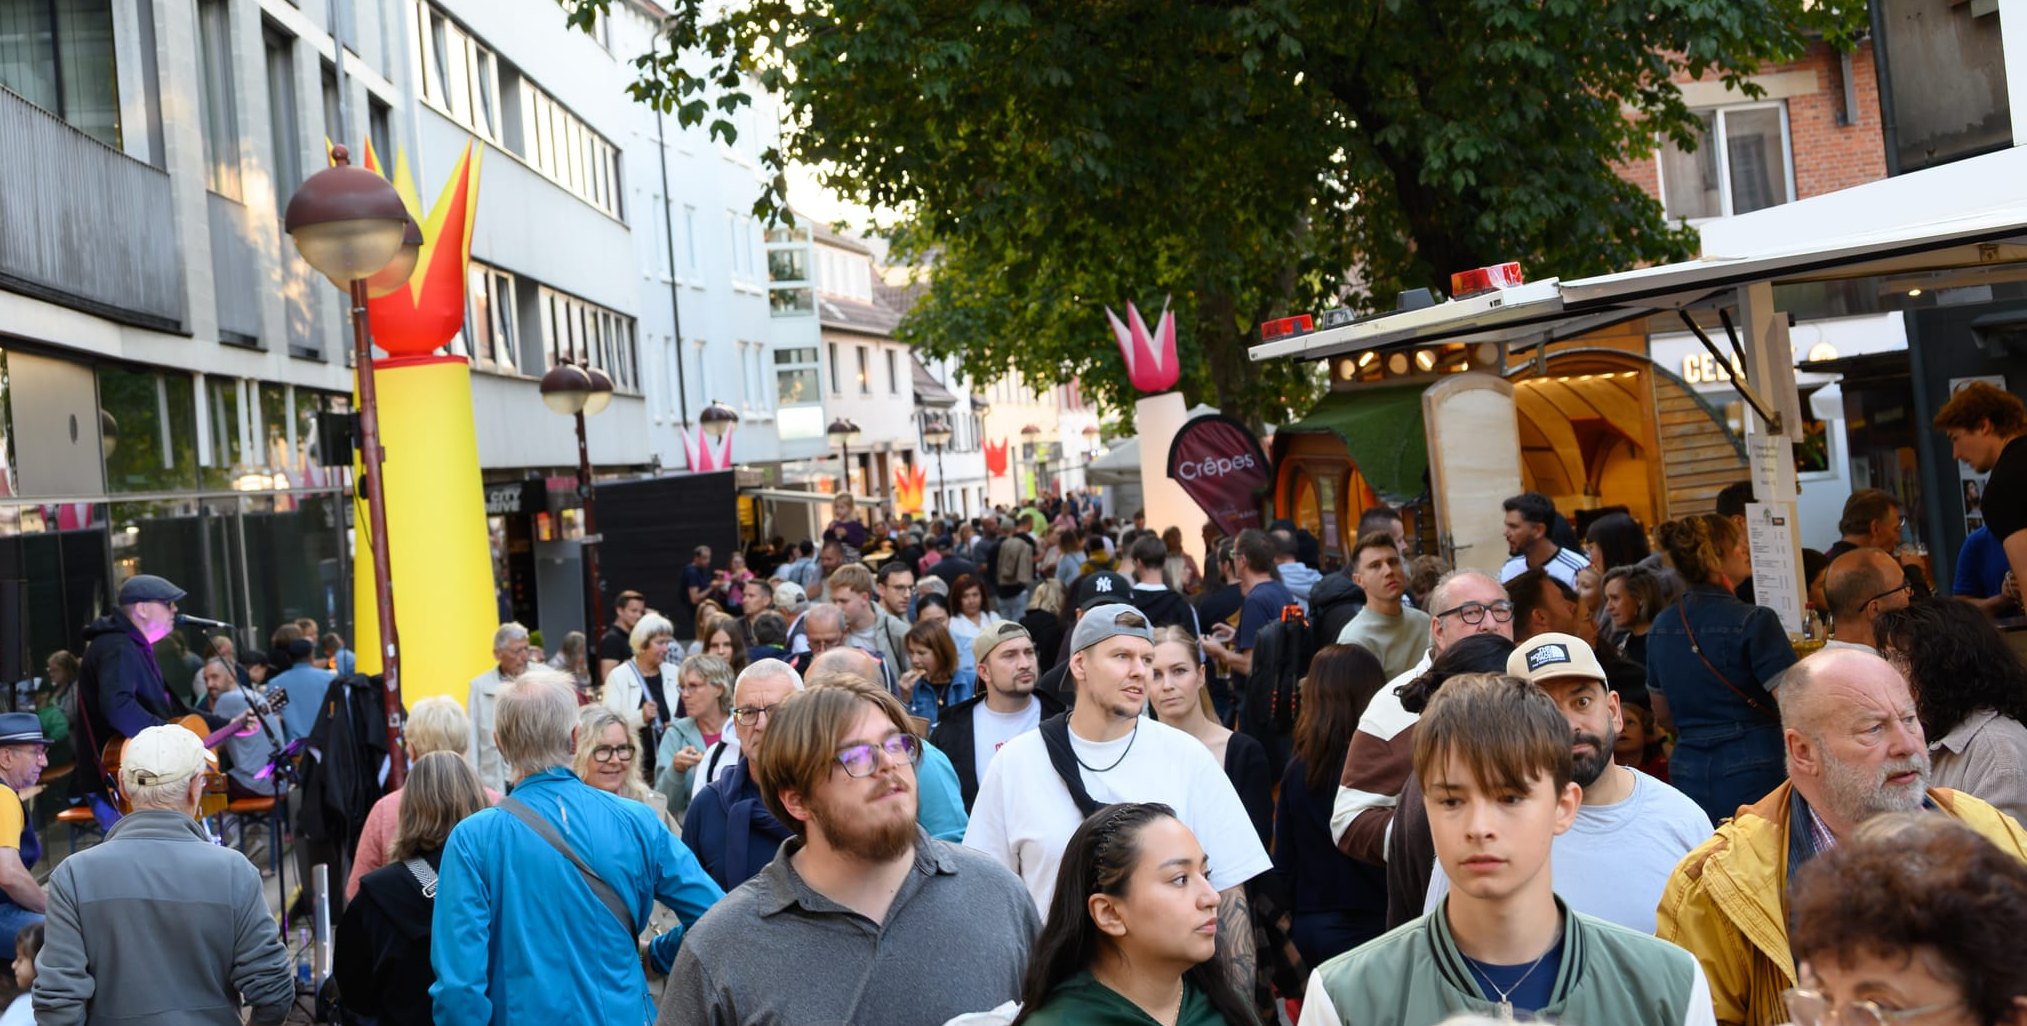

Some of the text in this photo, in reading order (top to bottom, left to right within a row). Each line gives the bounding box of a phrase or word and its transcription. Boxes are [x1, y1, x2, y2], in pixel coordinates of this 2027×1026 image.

[1178, 453, 1255, 480] Crêpes
[490, 486, 522, 501] CITY
[1095, 576, 1113, 592] NY
